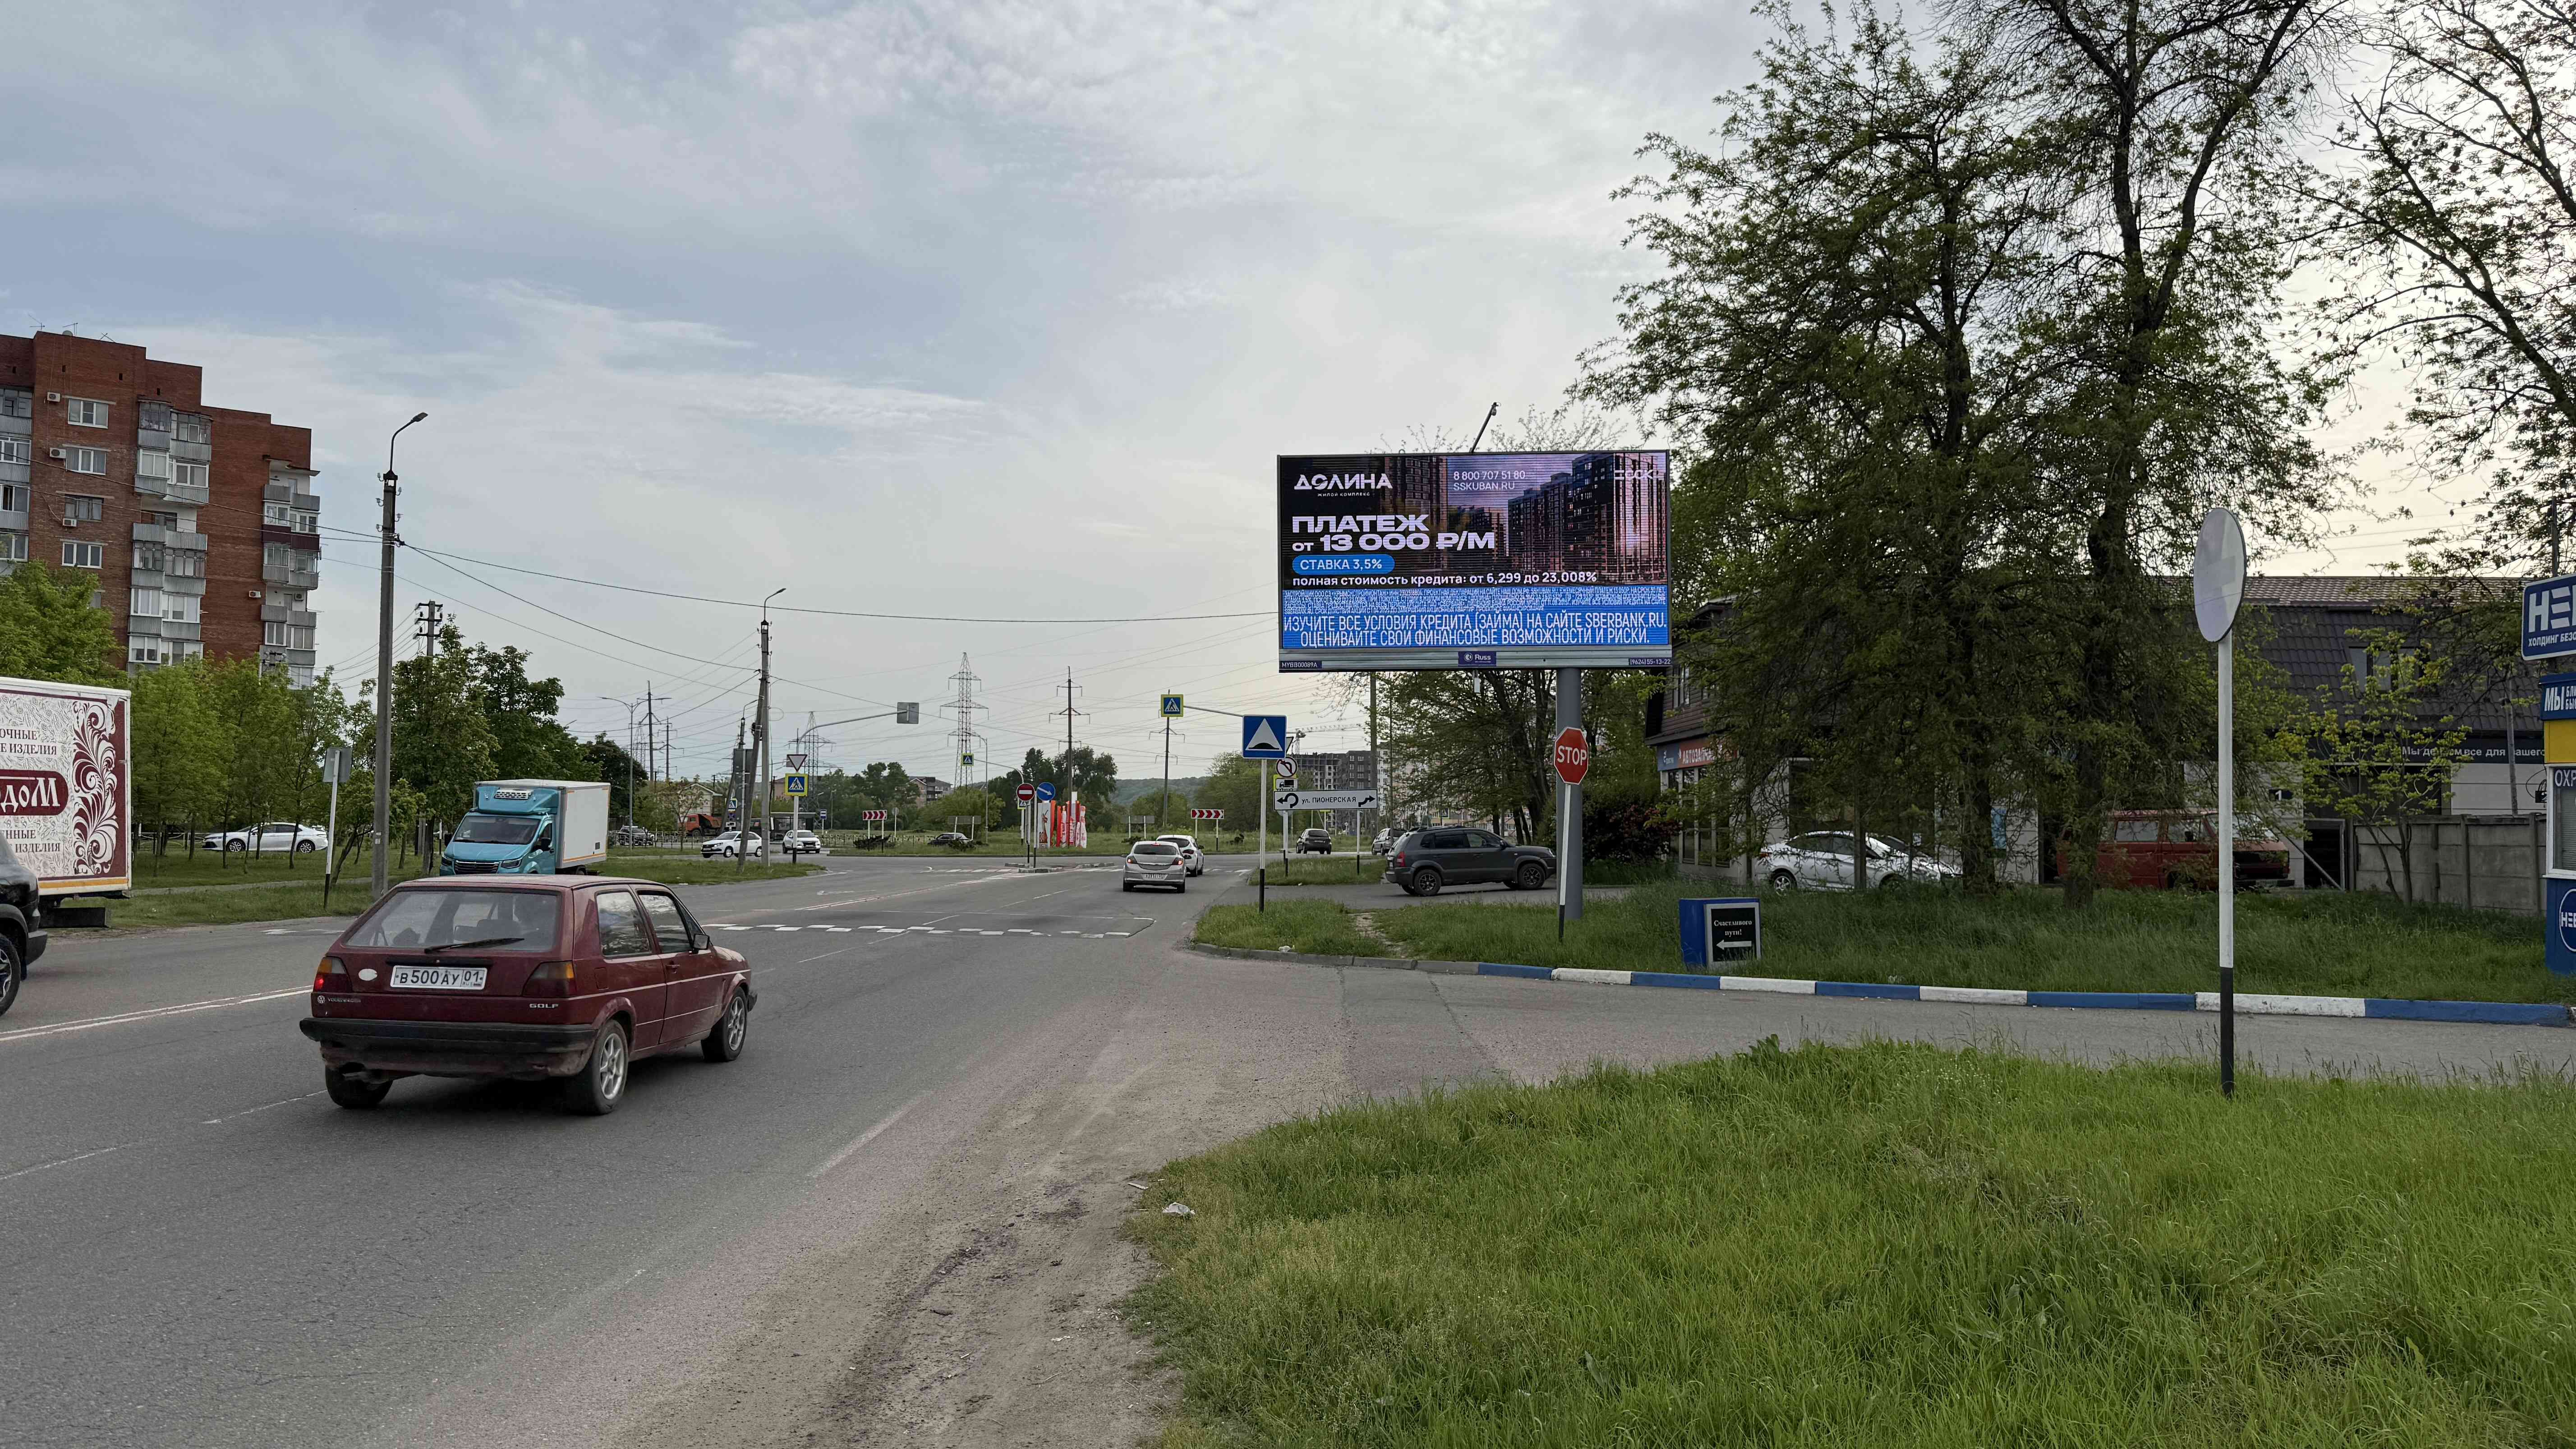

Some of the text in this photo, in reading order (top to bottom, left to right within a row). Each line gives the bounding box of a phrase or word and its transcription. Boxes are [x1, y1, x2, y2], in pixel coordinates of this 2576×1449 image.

[1294, 473, 1393, 490] ДОЛИНА
[1454, 470, 1525, 480] 8 800 707 51 80
[1454, 482, 1515, 491] SSKUBAN.RU
[1292, 514, 1429, 533] ПЛАТЕЖ
[1320, 534, 1353, 551] 13
[1358, 533, 1430, 551] 000
[1300, 558, 1382, 571] СТАВКА 3,5%
[1293, 571, 1597, 587] полная стоимость кредита: от 6,299 до 23,008%
[2528, 584, 2576, 633] НЕ
[1284, 616, 1335, 632] ИЗУЧИТЕ
[1338, 615, 1362, 631] ВСЕ
[1364, 615, 1417, 631] УСЛОВИЯ
[1420, 614, 1472, 631] КРЕДИТА
[1527, 613, 1542, 628] НА
[1546, 610, 1582, 628] САЙТЕ
[1585, 612, 1667, 628] SBERBANK.RU.
[1301, 628, 1650, 649] ОЦЕНИВАЙТЕ СВОИ ФИНАНСОВЫЕ ВОЗМОЖНОСТИ И РИСКИ.
[2528, 634, 2559, 647] ХОЛДИНГ
[2544, 686, 2565, 711] МЫ
[9, 743, 57, 755] ИЗДЕЛИЯ
[1557, 745, 1587, 766] STOP
[2402, 746, 2420, 755] Мы
[2485, 749, 2506, 757] для
[1, 830, 36, 839] ННЫЕ
[15, 843, 60, 854] ИЗДЕЛИЯ
[1725, 929, 1742, 938] пути!
